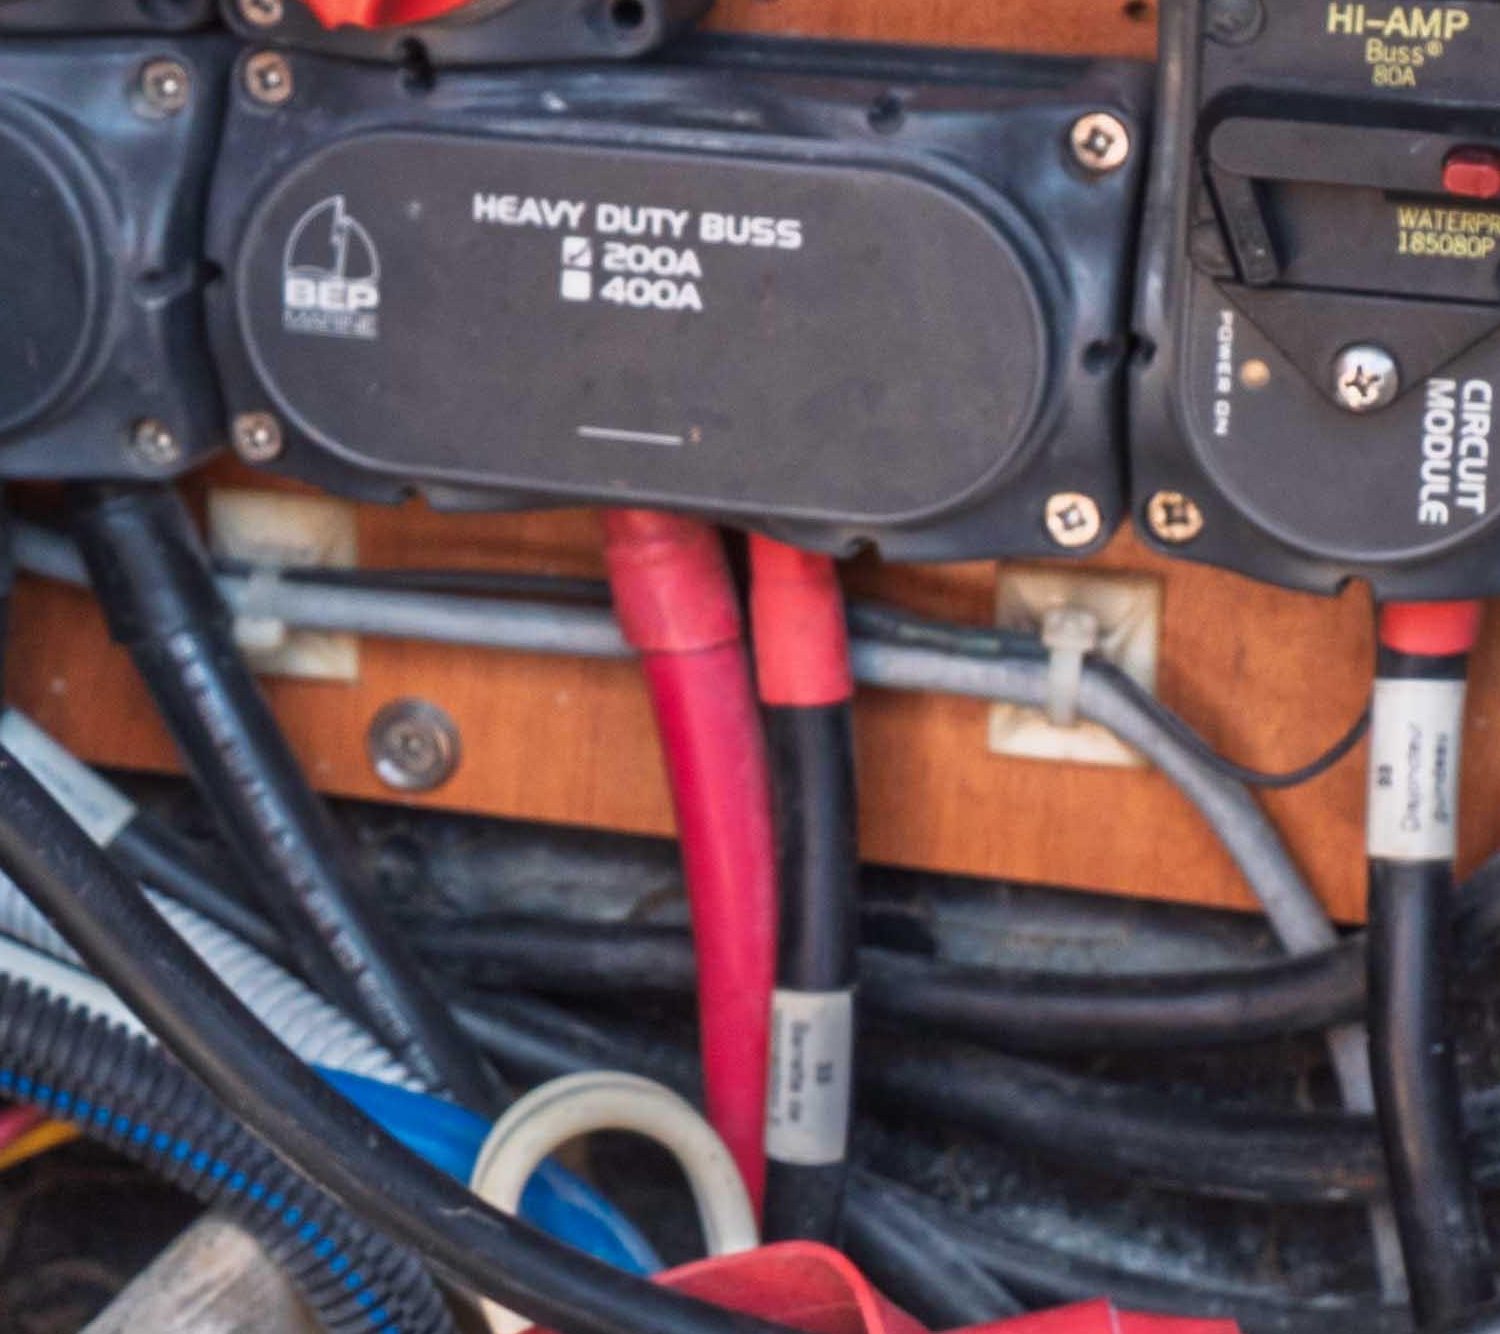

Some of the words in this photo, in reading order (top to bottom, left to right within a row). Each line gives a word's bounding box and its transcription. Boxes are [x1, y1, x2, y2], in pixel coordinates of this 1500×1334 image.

[1325, 2, 1471, 41] HI-AMP
[472, 192, 586, 230] HEAVY
[595, 202, 691, 238] DUTY
[700, 212, 804, 250] BUSS
[602, 242, 703, 277] 200A
[283, 275, 380, 312] BEP
[600, 277, 703, 313] 400A
[1417, 377, 1457, 526] MODULE
[1456, 378, 1494, 516] CIRCUIT
